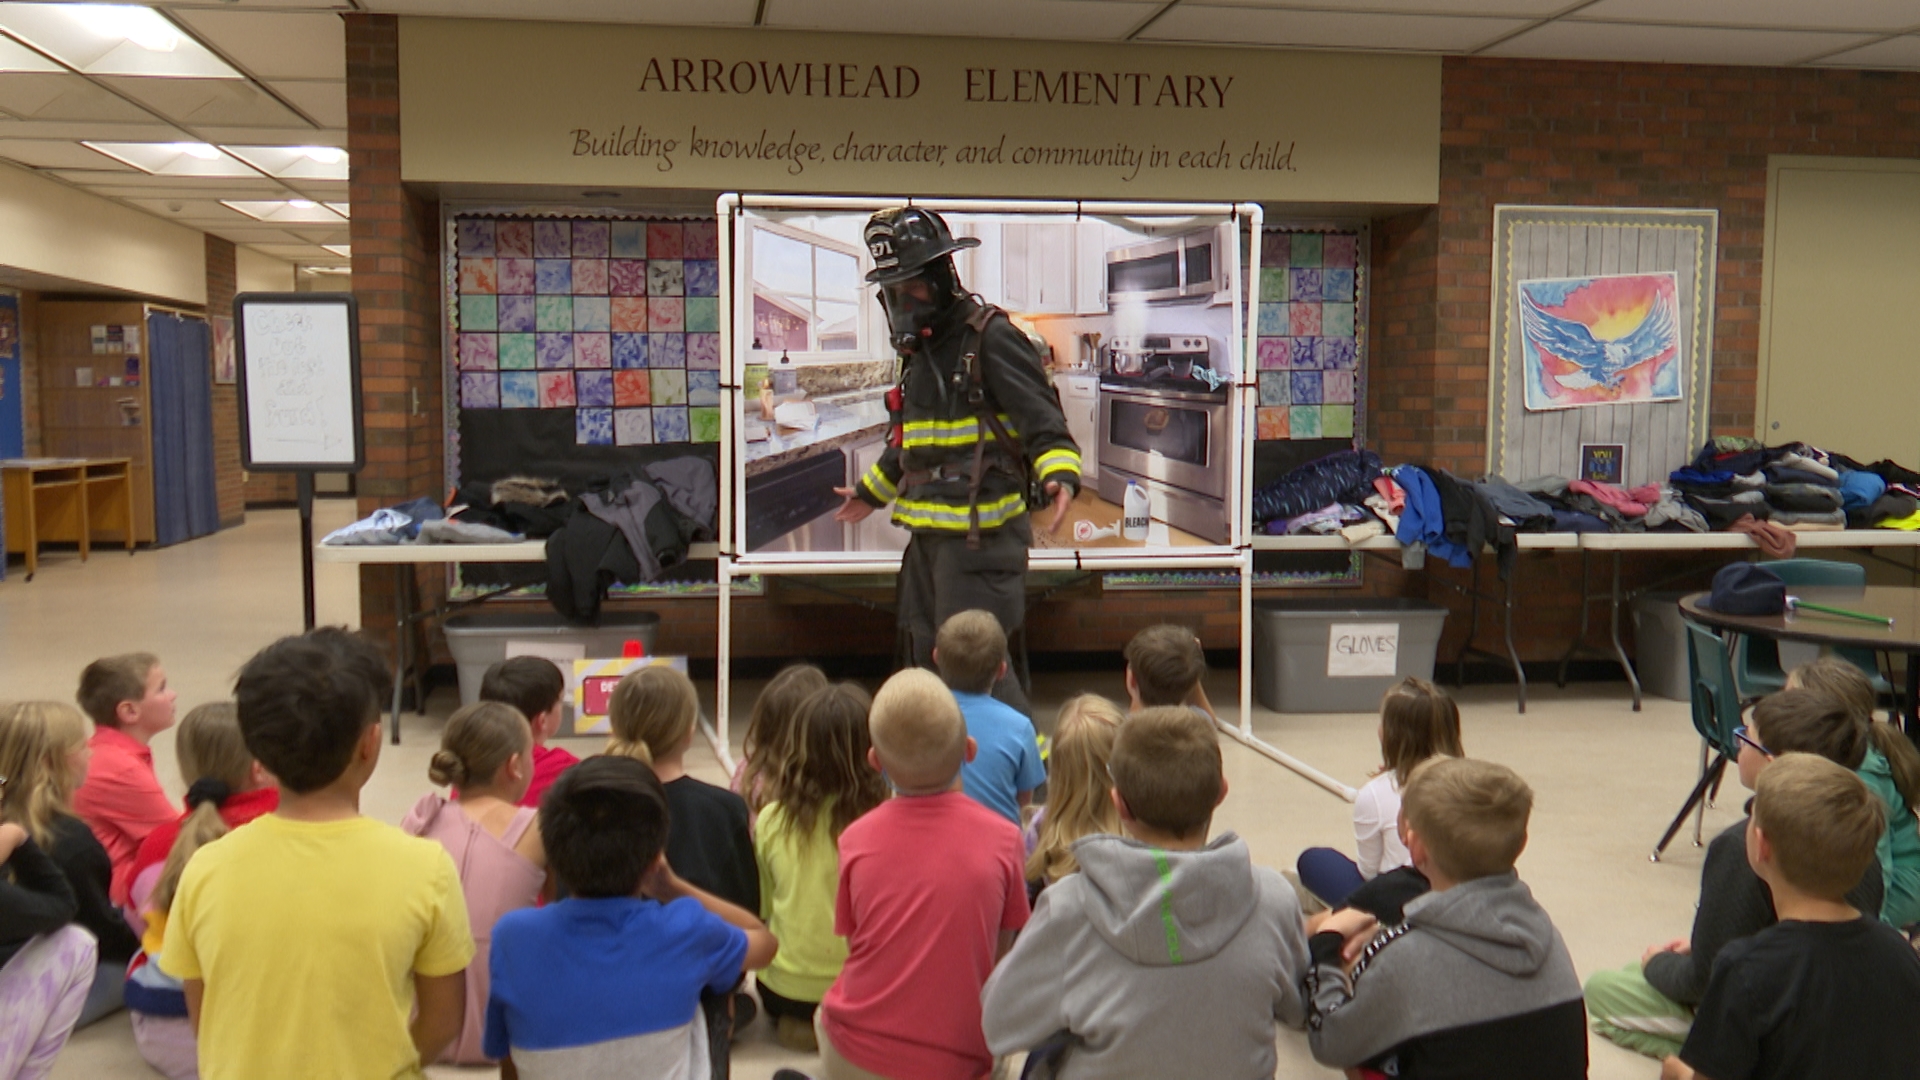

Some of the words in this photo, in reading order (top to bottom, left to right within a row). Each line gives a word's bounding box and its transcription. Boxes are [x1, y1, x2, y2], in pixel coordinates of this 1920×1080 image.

[637, 57, 921, 99] ARROWHEAD
[964, 67, 1235, 108] ELEMENTARY
[570, 125, 681, 172] Building
[689, 125, 825, 175] knowledge,
[832, 131, 949, 168] character,
[955, 134, 1007, 165] and
[1012, 142, 1144, 182] community
[1149, 144, 1171, 169] in
[1178, 139, 1232, 170] each
[1239, 141, 1298, 172] child.
[1124, 517, 1150, 528] BLEACH
[1335, 635, 1397, 655] GLOVES
